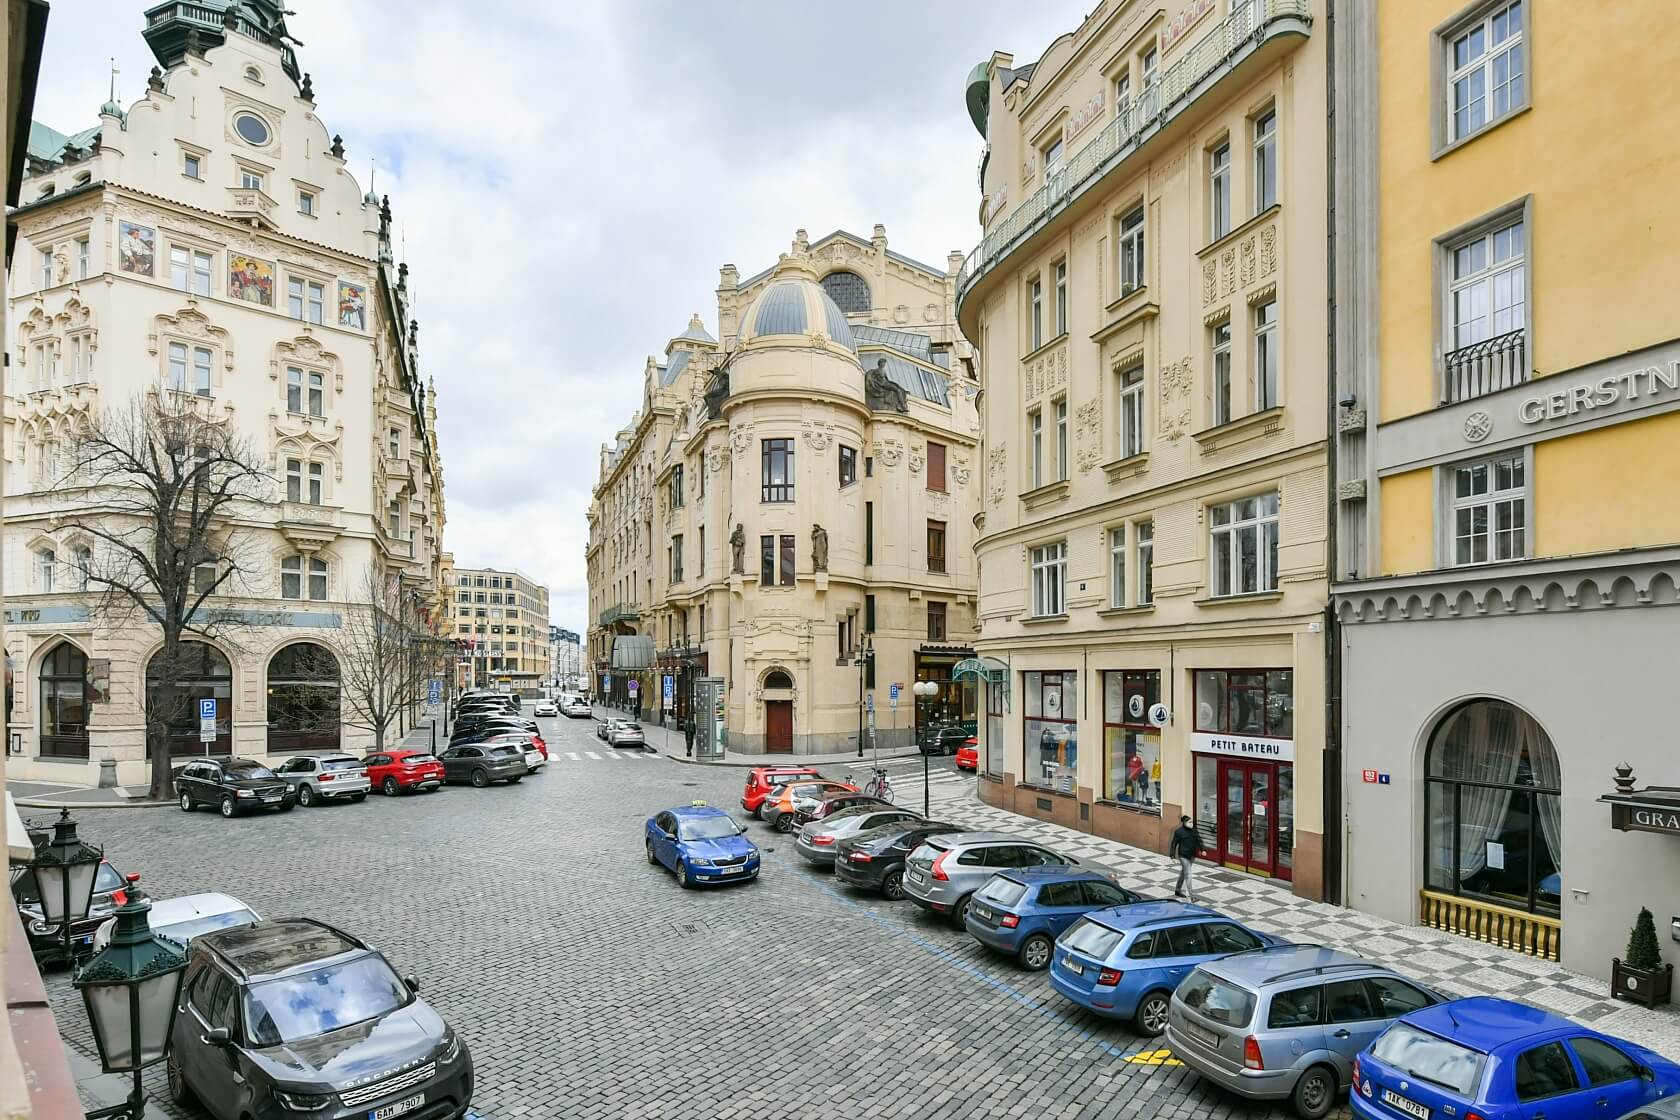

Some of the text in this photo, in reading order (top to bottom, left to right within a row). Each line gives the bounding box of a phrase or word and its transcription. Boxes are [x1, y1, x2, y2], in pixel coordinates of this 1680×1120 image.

[1211, 740, 1280, 754] PETIT BATEAU
[1635, 811, 1680, 829] GRA
[346, 1056, 426, 1087] DISCOVERY
[376, 1096, 421, 1119] 6AM 7907
